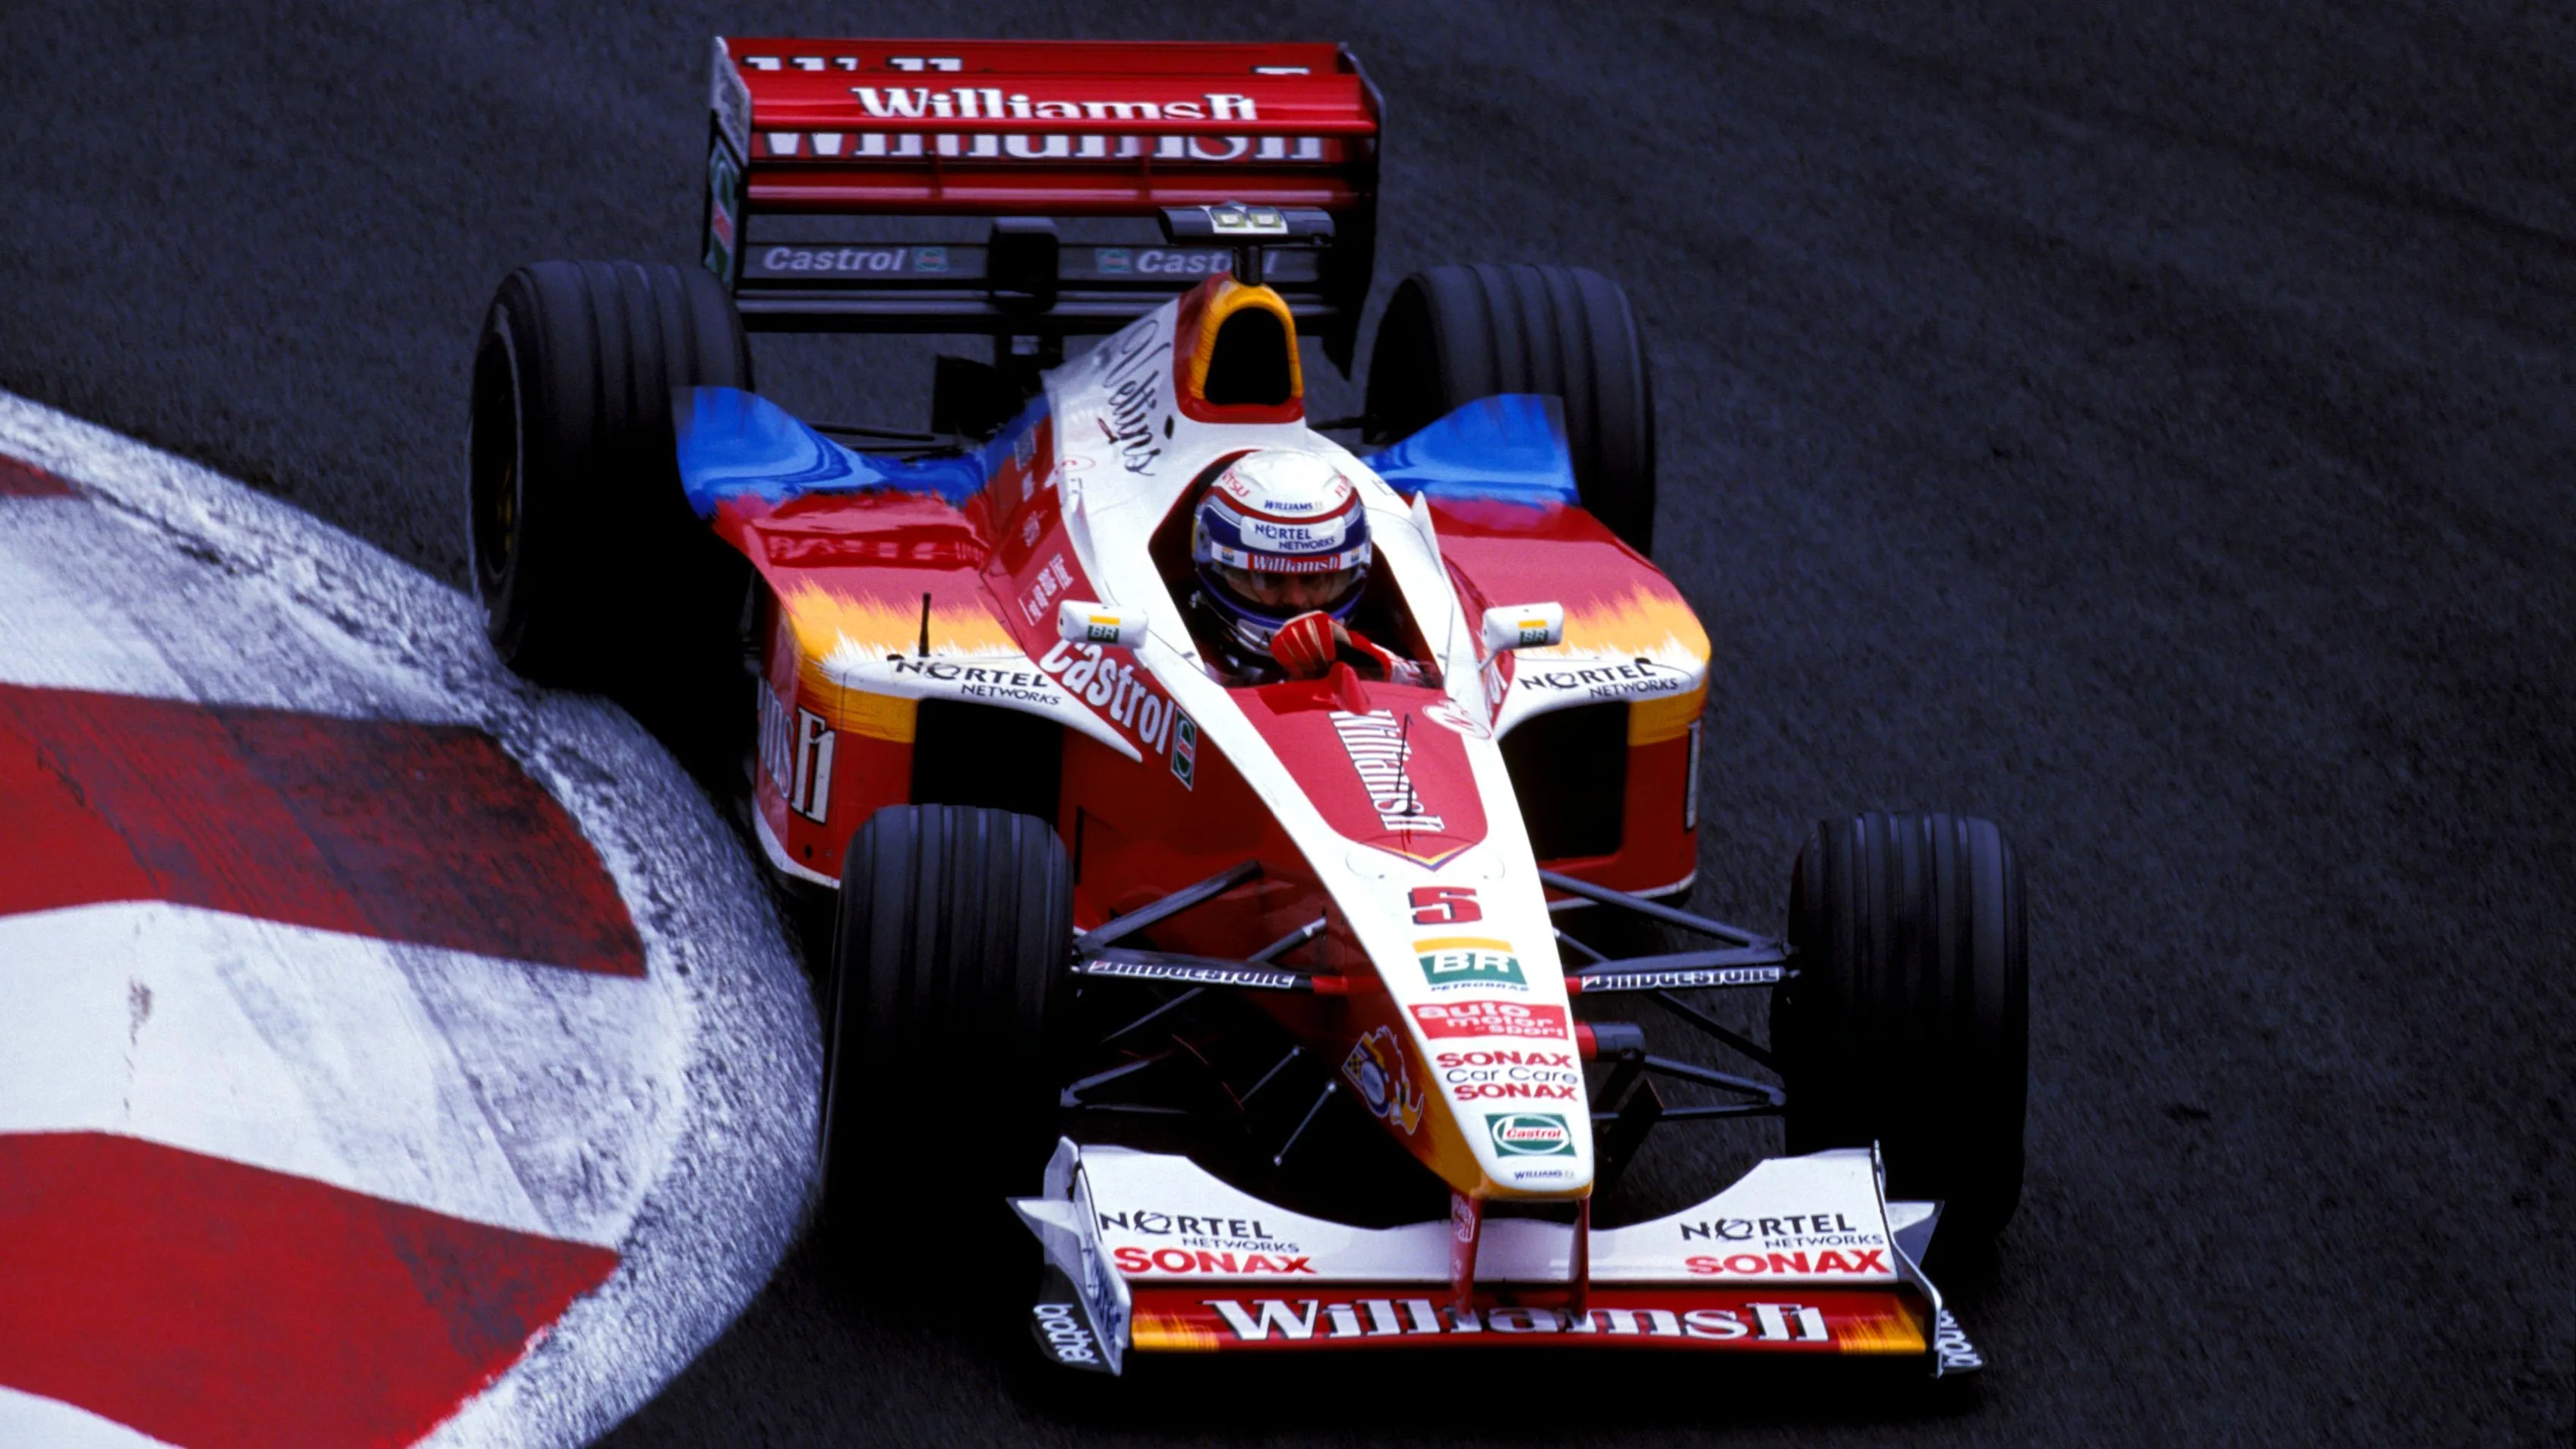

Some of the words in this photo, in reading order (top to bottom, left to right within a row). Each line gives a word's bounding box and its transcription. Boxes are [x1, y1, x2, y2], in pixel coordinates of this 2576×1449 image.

[763, 247, 908, 272] Castrol
[1102, 320, 1171, 476] Veltins
[1255, 522, 1312, 540] NORTEL
[1279, 536, 1336, 550] NETWORKS
[1091, 627, 1117, 639] BR
[897, 659, 1049, 687] NORTEL
[1519, 661, 1657, 690] NORTEL
[961, 684, 1061, 706] NETWORKS
[1040, 639, 1174, 755] Castrol
[1589, 677, 1679, 699] NETWORKS
[1407, 886, 1482, 925] 5
[1432, 952, 1511, 974] BR
[1417, 1002, 1531, 1018] auto
[1447, 1015, 1554, 1028] motor
[1488, 1024, 1564, 1037] sport
[1436, 1050, 1574, 1069] SONAX
[1446, 1068, 1500, 1084] Car
[1508, 1066, 1579, 1084] Care
[1454, 1084, 1578, 1102] SONAX
[1506, 1127, 1562, 1140] Castrol
[1098, 1210, 1274, 1239] NORTEL
[1680, 1213, 1857, 1241] NORTEL
[1182, 1236, 1299, 1253] NETWORKS
[1764, 1233, 1885, 1249] NETWORKS
[1113, 1246, 1318, 1274] SONAX
[1684, 1249, 1892, 1275] SONAX
